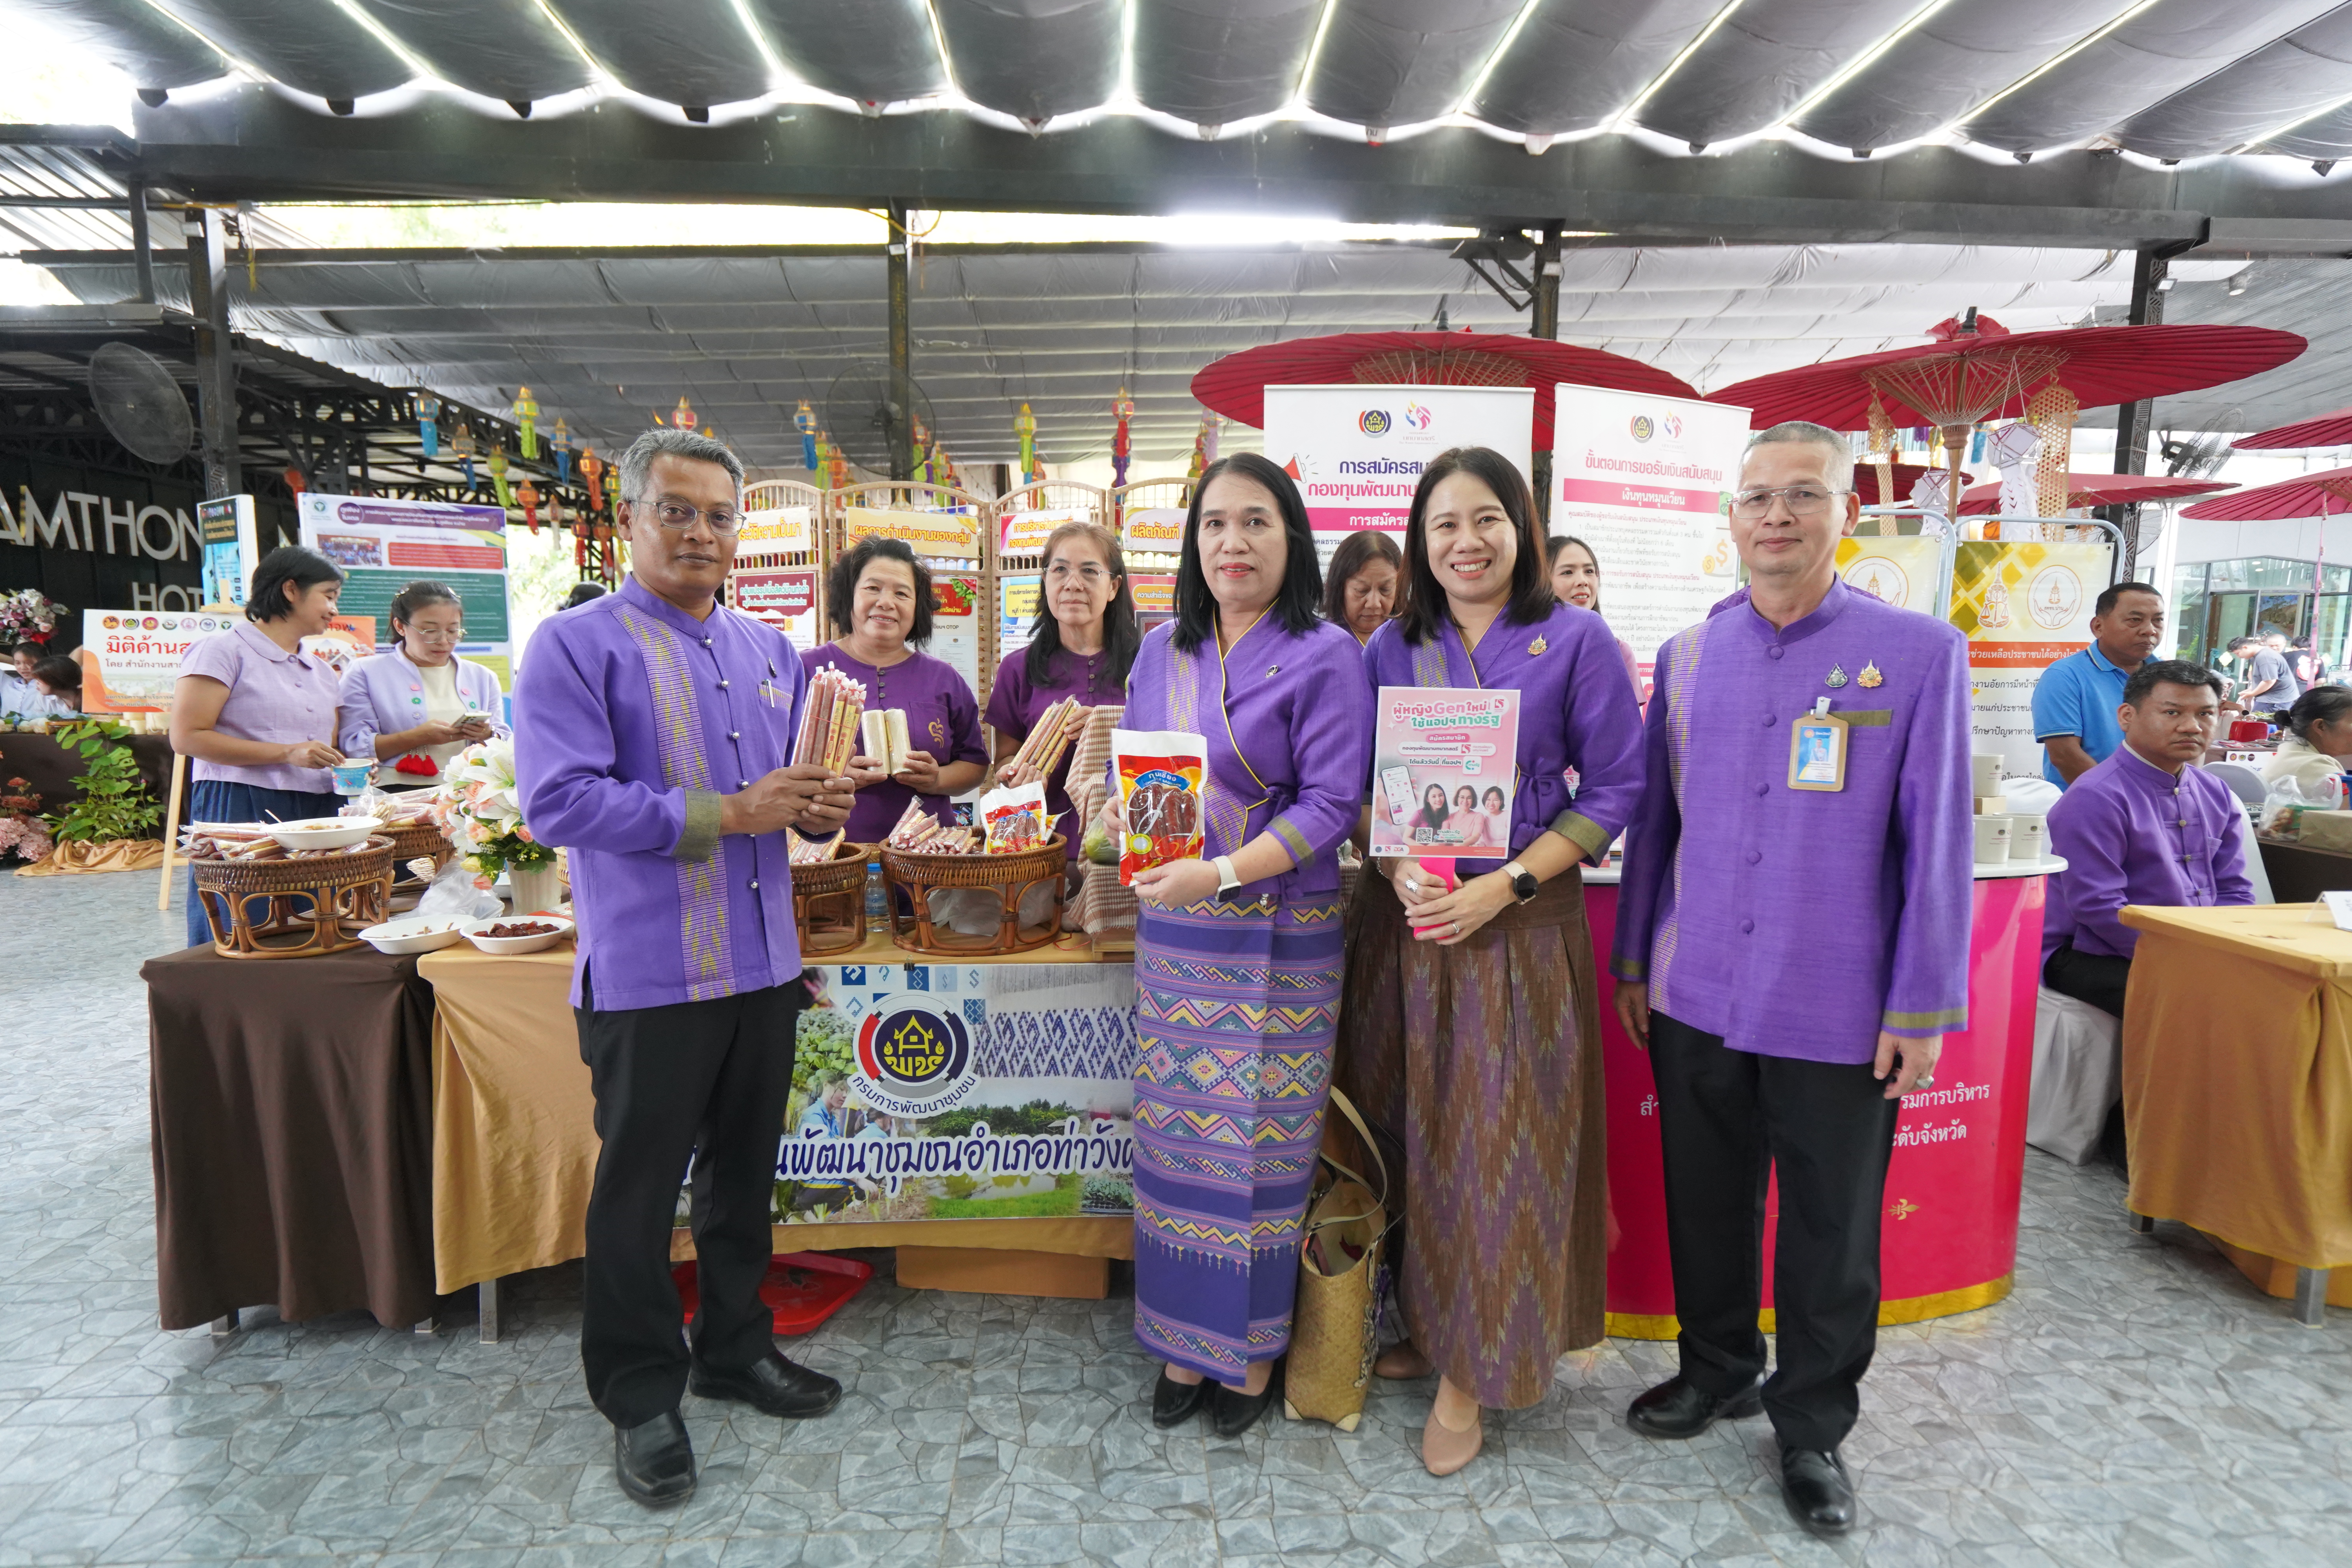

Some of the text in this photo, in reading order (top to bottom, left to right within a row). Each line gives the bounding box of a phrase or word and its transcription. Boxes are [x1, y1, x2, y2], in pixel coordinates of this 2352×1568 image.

[1586, 449, 1722, 485] ขั้นตอนการขอรับเงินสนับสนุน
[1622, 486, 1685, 508] เงินทุนหมุนเวียน
[1131, 522, 1180, 539] ผลิตภัณฑ์
[105, 659, 122, 667] โดย
[1434, 702, 1465, 714] Gen
[1149, 771, 1176, 781] กุนเชียง
[852, 1074, 976, 1114] กรมการพัฒนาชุมชน
